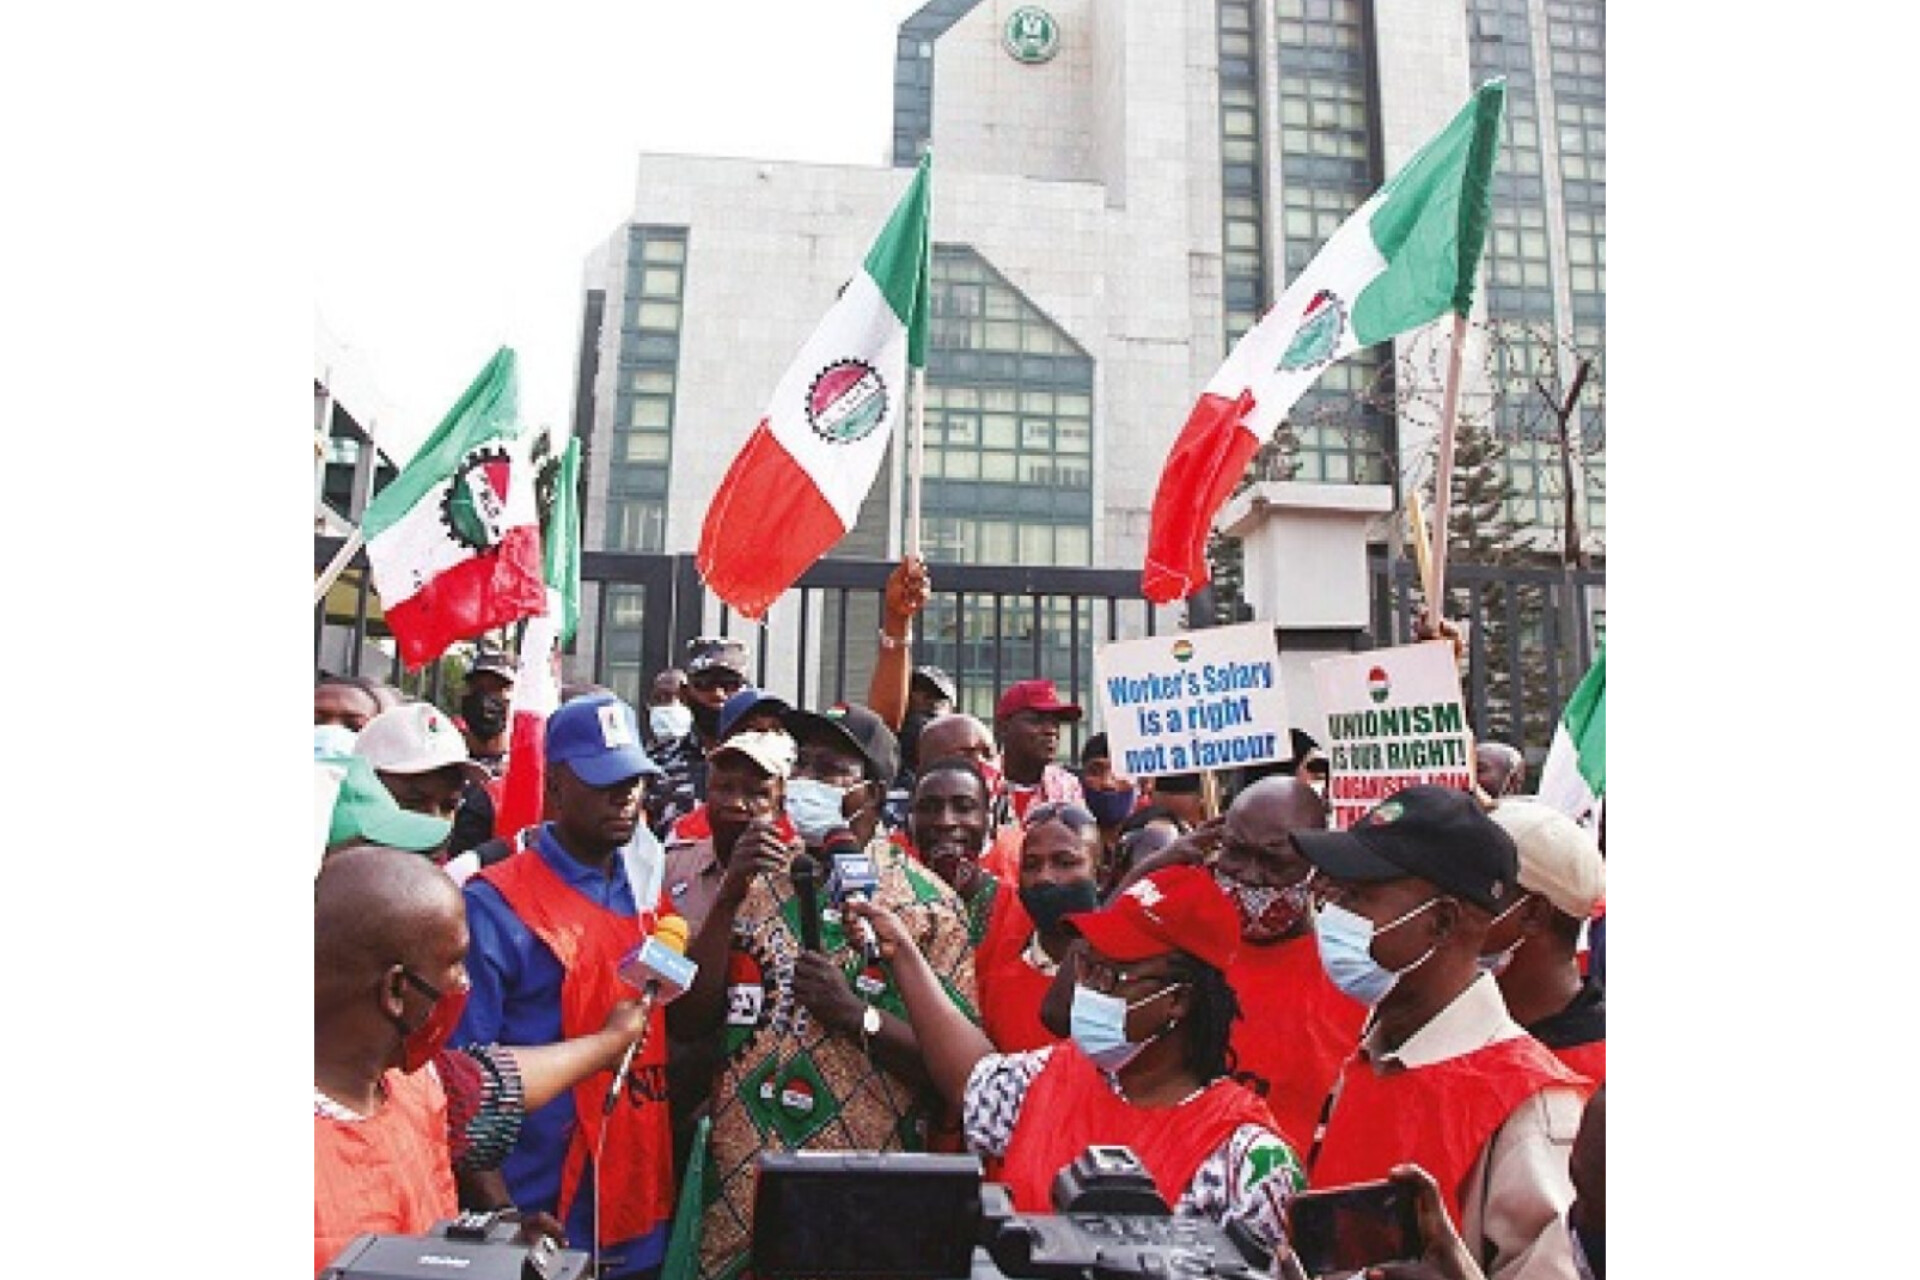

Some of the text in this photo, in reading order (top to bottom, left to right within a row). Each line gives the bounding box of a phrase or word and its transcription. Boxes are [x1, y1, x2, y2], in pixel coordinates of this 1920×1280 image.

[1107, 661, 1273, 706] Worker's Salary
[1139, 696, 1252, 736] is a right
[1328, 702, 1462, 740] UNIONISM
[1125, 735, 1275, 774] not a favour
[1331, 738, 1467, 770] IS OUR RIGHT!
